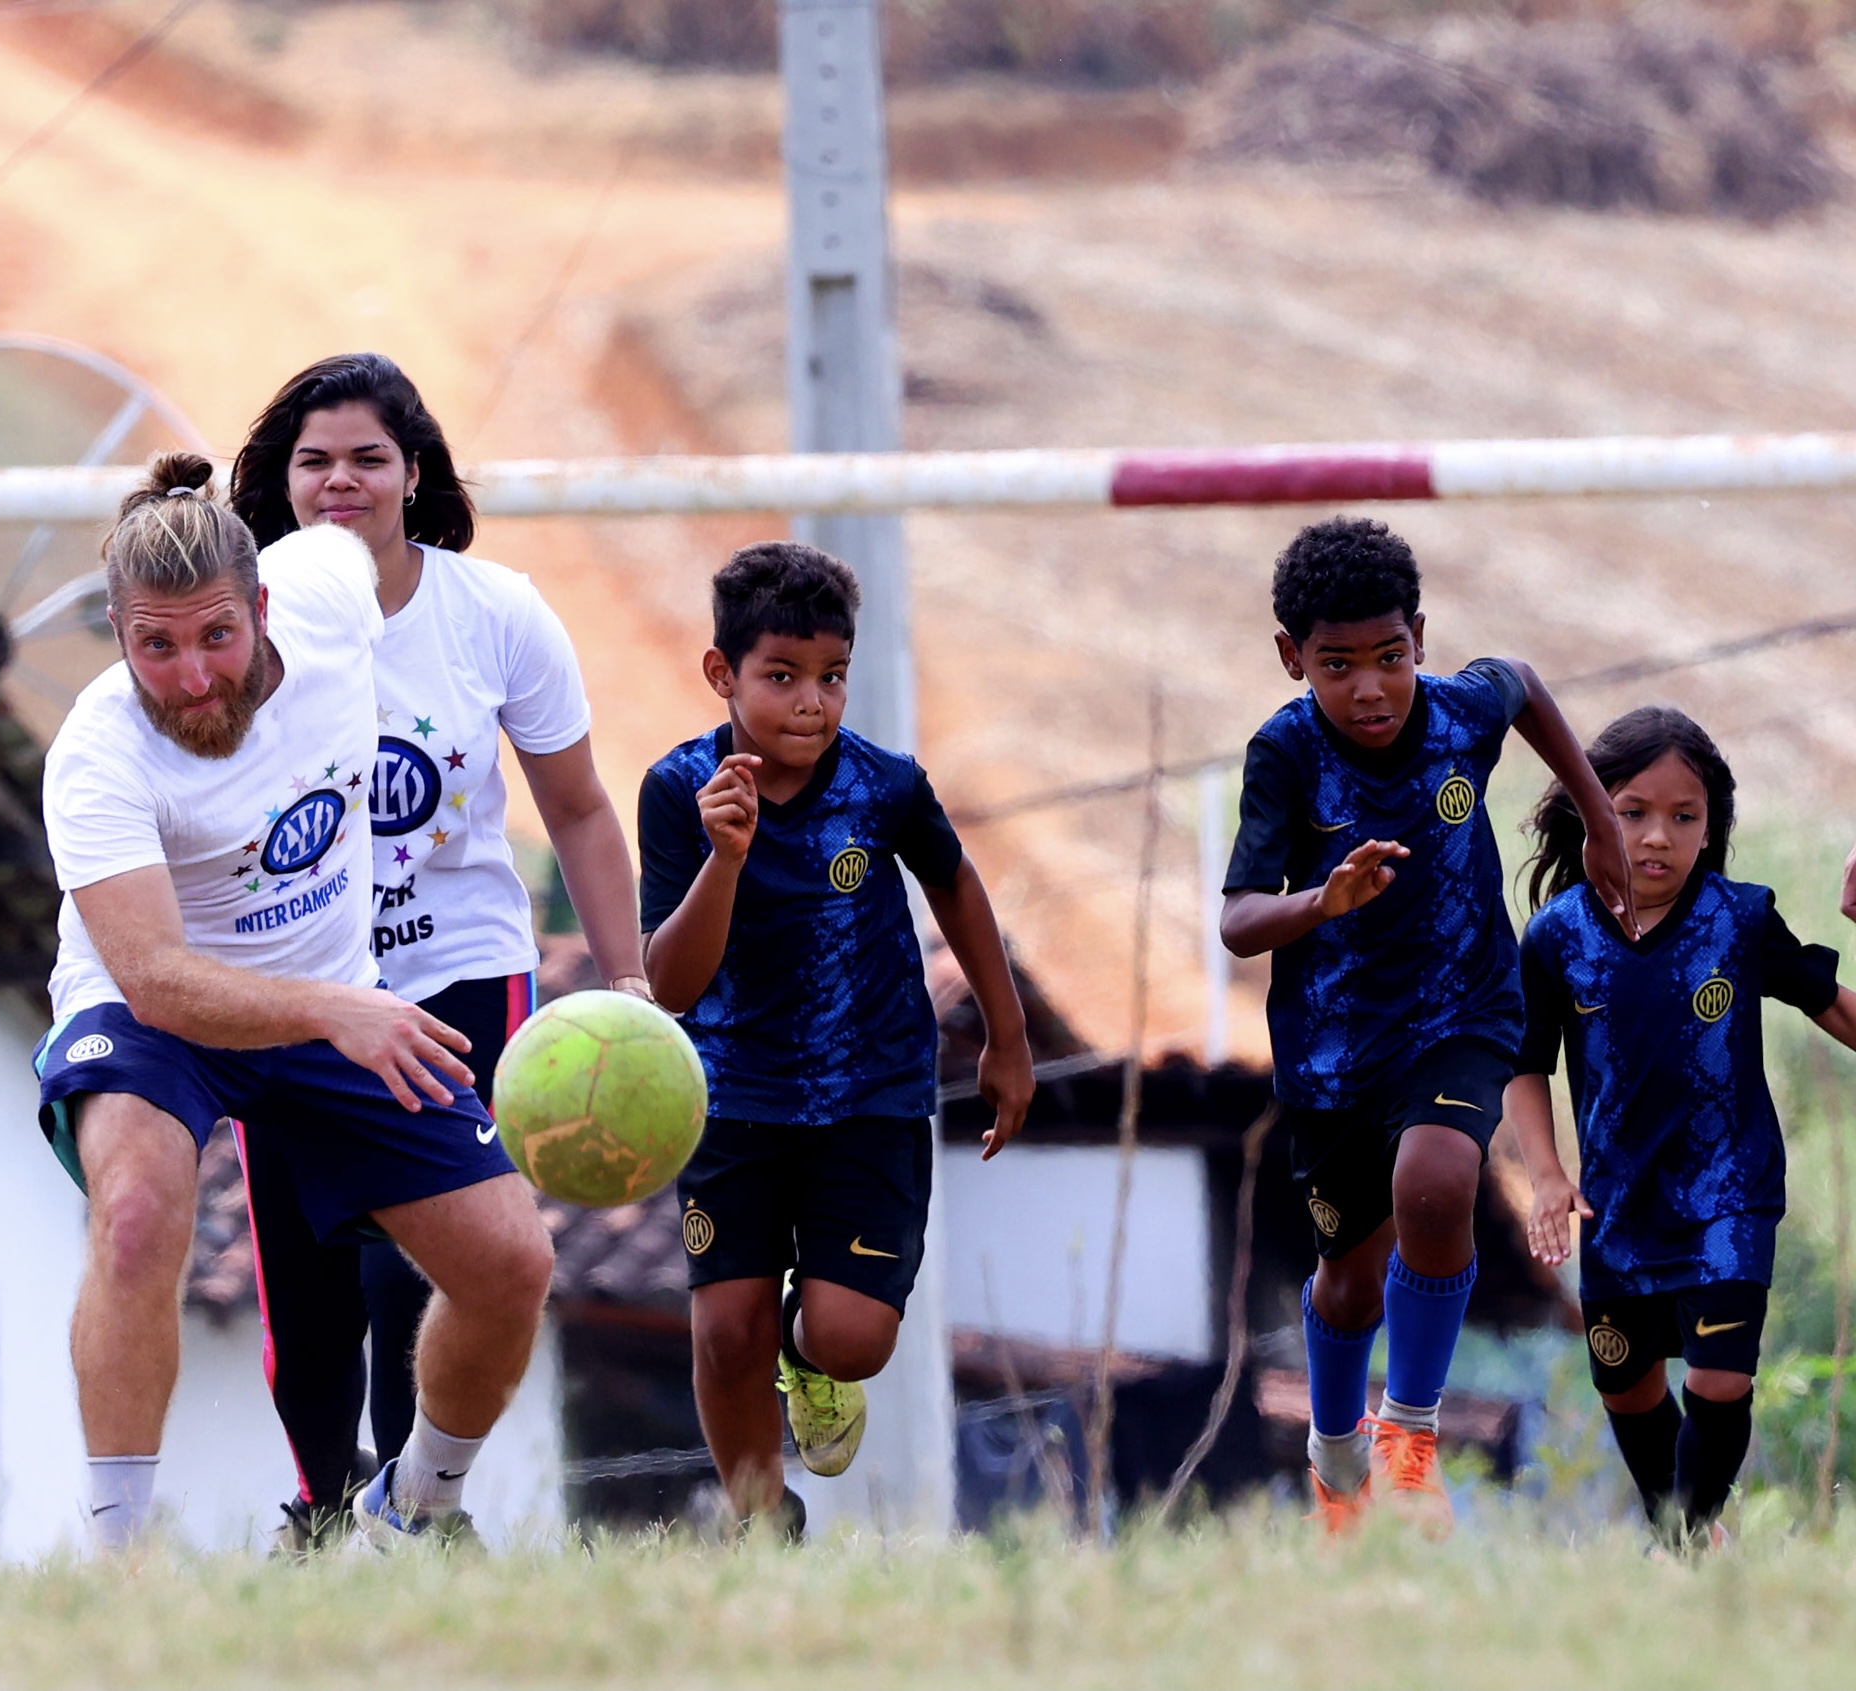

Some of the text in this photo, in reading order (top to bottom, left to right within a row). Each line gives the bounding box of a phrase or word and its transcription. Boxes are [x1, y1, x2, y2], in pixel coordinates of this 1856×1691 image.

[235, 868, 348, 933] INTER CAMPUS
[369, 914, 434, 958] pus
